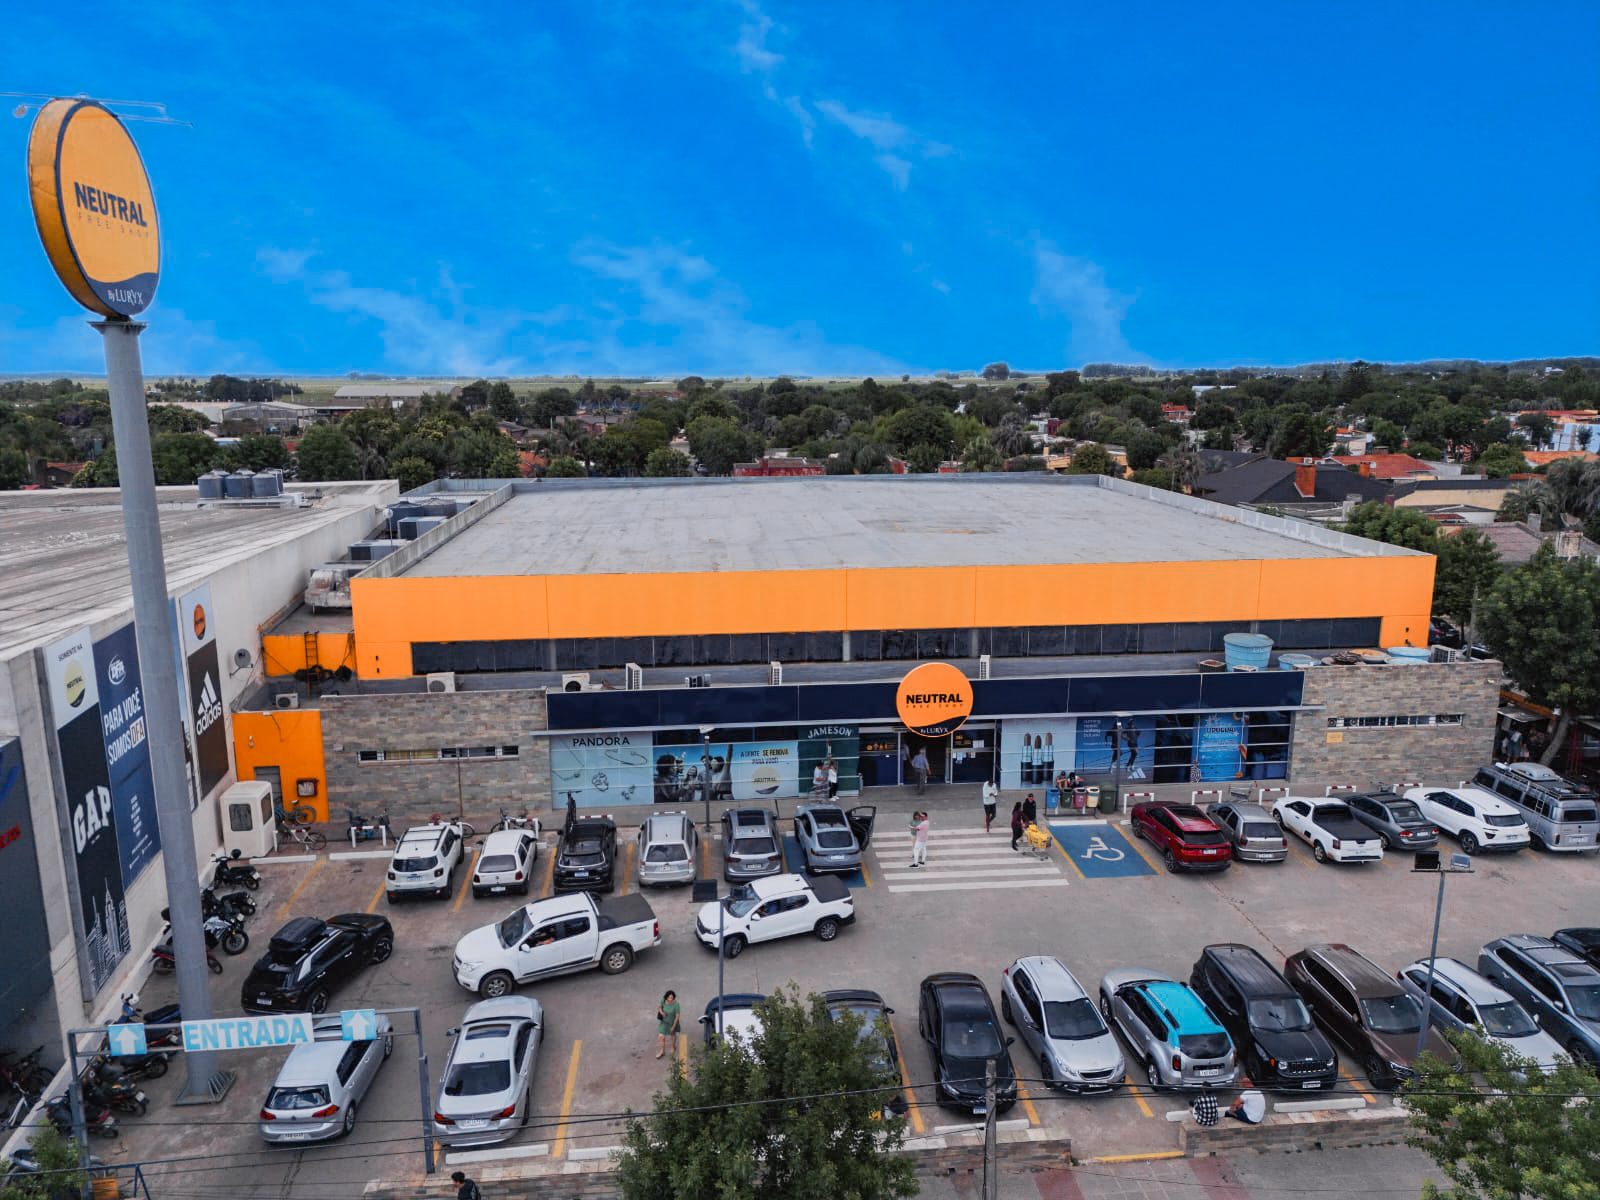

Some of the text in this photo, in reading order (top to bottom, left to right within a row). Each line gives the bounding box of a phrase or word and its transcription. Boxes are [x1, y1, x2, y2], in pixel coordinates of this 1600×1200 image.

[74, 182, 147, 227] NEUTRAL
[115, 288, 143, 305] LURYX
[104, 687, 141, 736] PARA VOCÊ
[906, 693, 963, 704] NEUTRAL
[196, 702, 222, 735] adidas
[807, 726, 852, 739] JAMESON
[108, 730, 131, 765] SOMOS
[572, 736, 630, 747] PANDORA
[73, 785, 112, 854] GAP
[186, 1018, 307, 1050] ENTRADA
